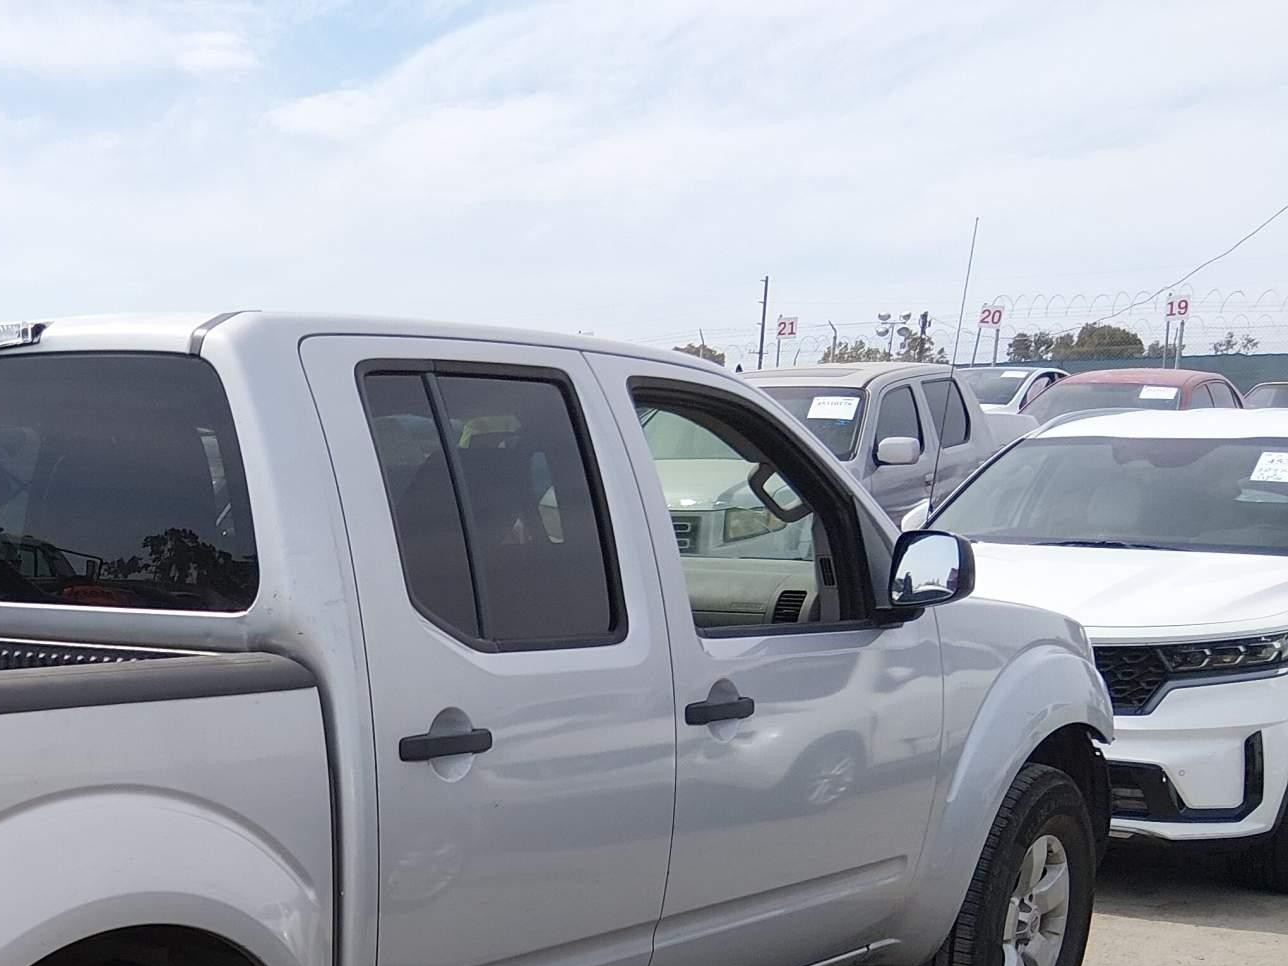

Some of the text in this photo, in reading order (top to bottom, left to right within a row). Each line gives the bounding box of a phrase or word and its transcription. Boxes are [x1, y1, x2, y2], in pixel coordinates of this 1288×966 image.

[1166, 299, 1189, 316] 19
[979, 308, 1002, 324] 20
[778, 321, 796, 336] 21
